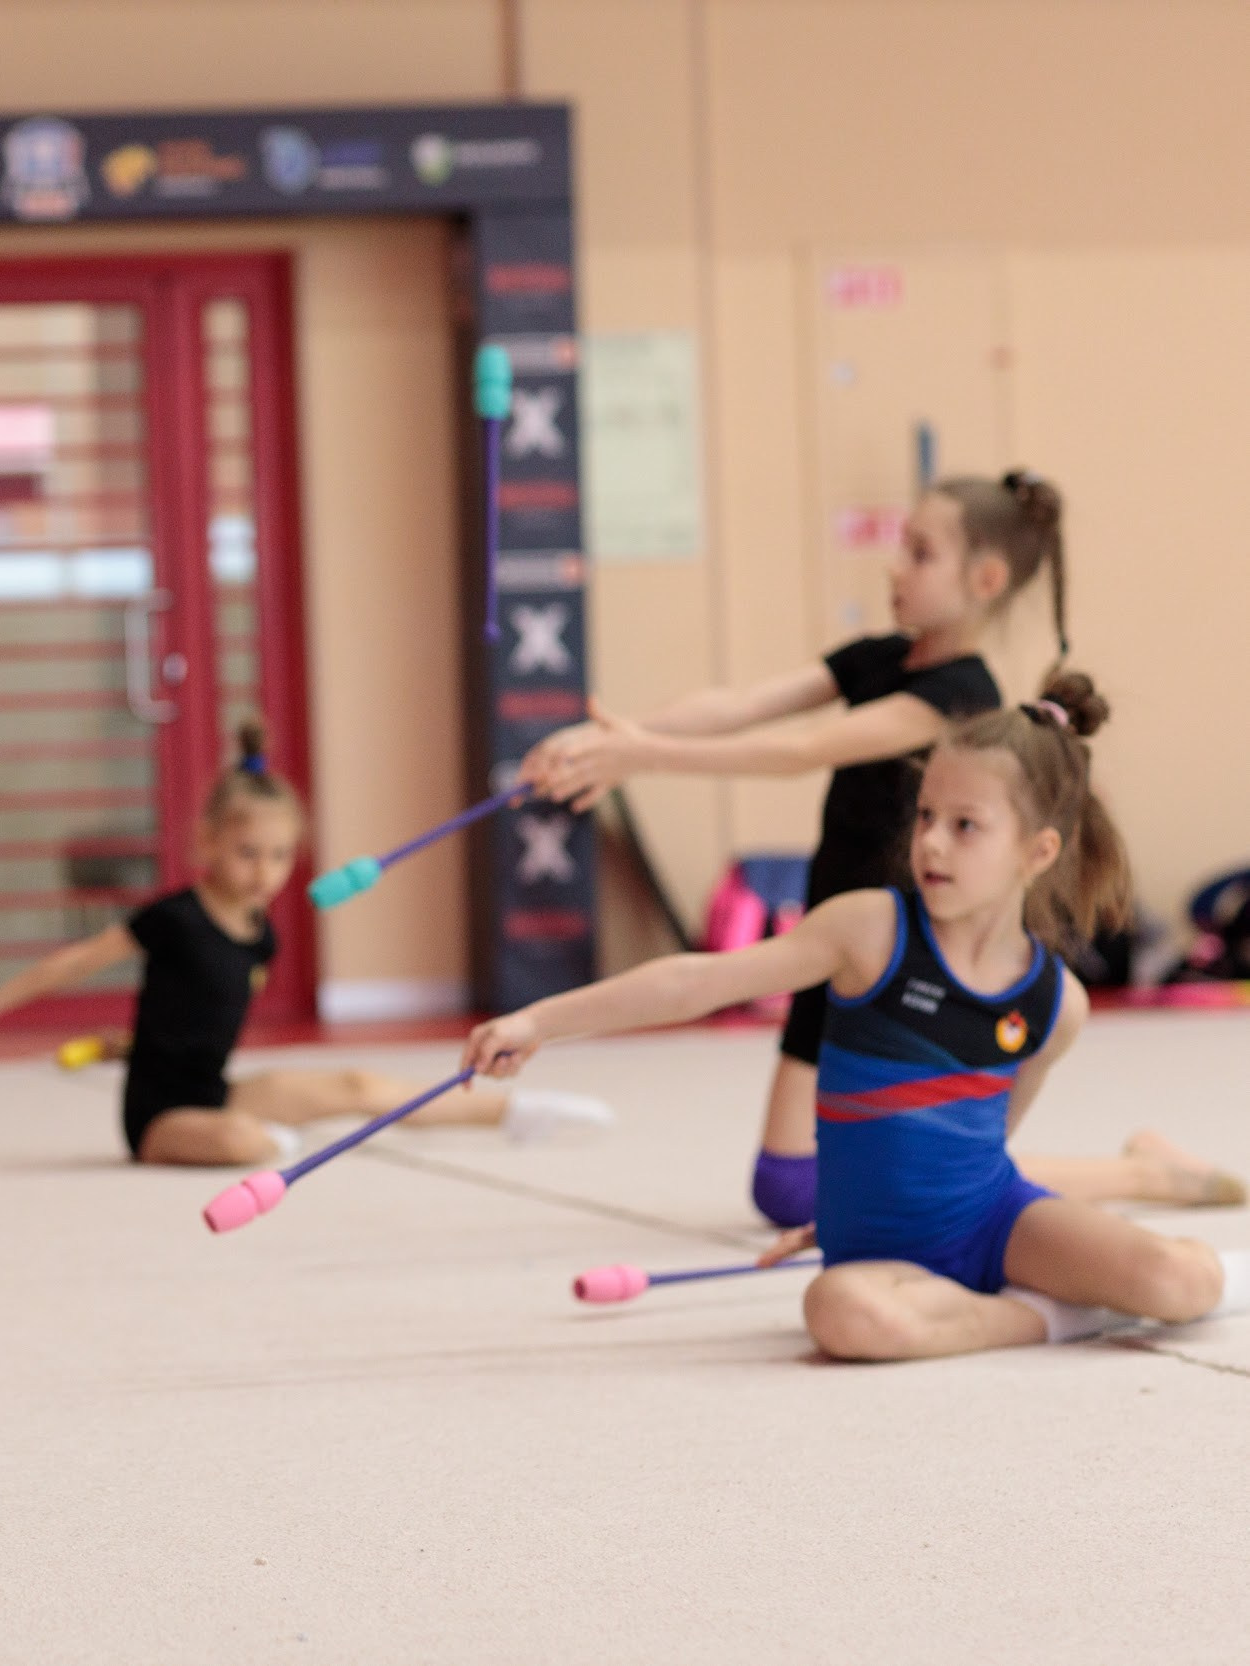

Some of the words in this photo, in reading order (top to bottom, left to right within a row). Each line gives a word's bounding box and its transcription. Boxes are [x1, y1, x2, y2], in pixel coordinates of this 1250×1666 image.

[506, 387, 566, 457] X
[510, 606, 571, 673] X
[516, 815, 573, 882] X
